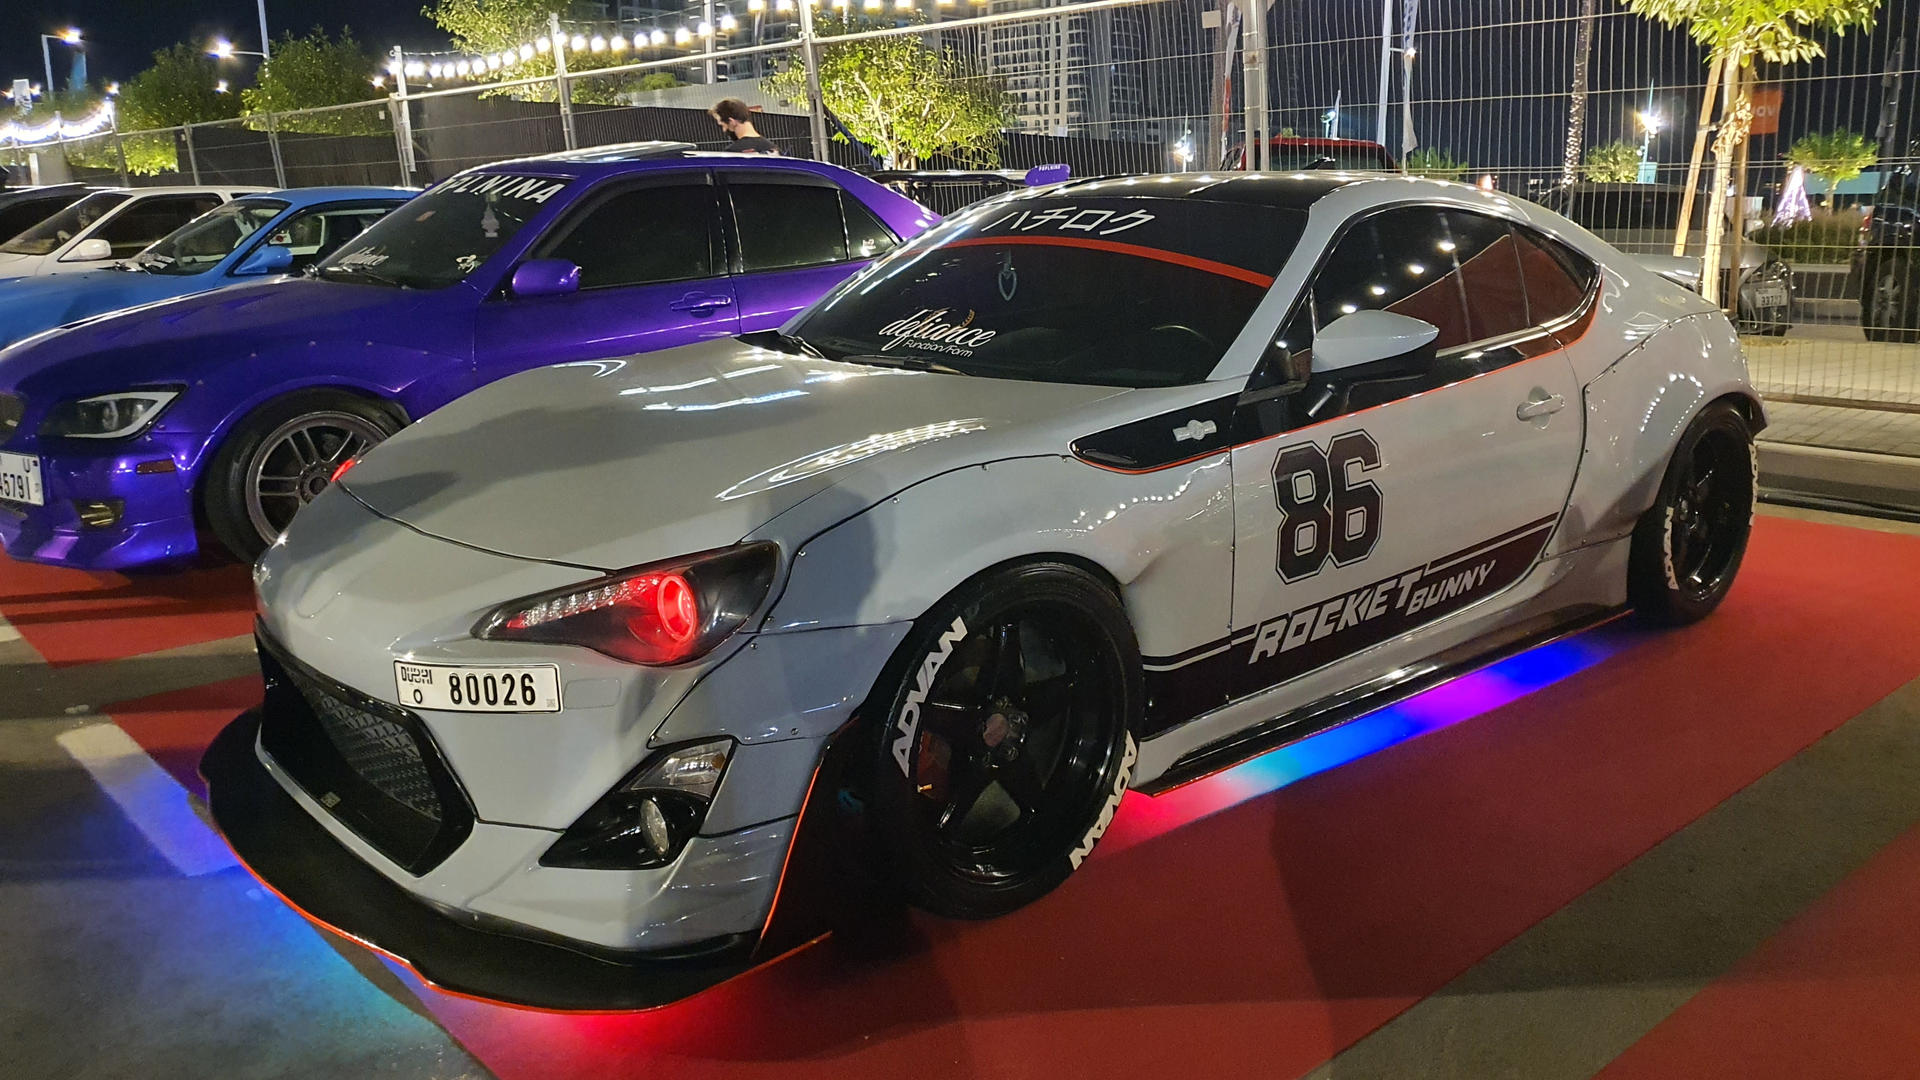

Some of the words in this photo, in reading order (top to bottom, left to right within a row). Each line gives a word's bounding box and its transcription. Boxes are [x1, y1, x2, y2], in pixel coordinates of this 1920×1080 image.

[981, 206, 1156, 236] ハチロク
[878, 309, 997, 352] defiance
[22, 457, 31, 473] U
[1271, 428, 1384, 585] 86
[1249, 564, 1427, 664] ROCKET
[1405, 559, 1497, 617] BUNNY
[448, 673, 536, 706] 80026
[892, 615, 968, 779] ADVAN
[1068, 729, 1139, 871] ADVAN
